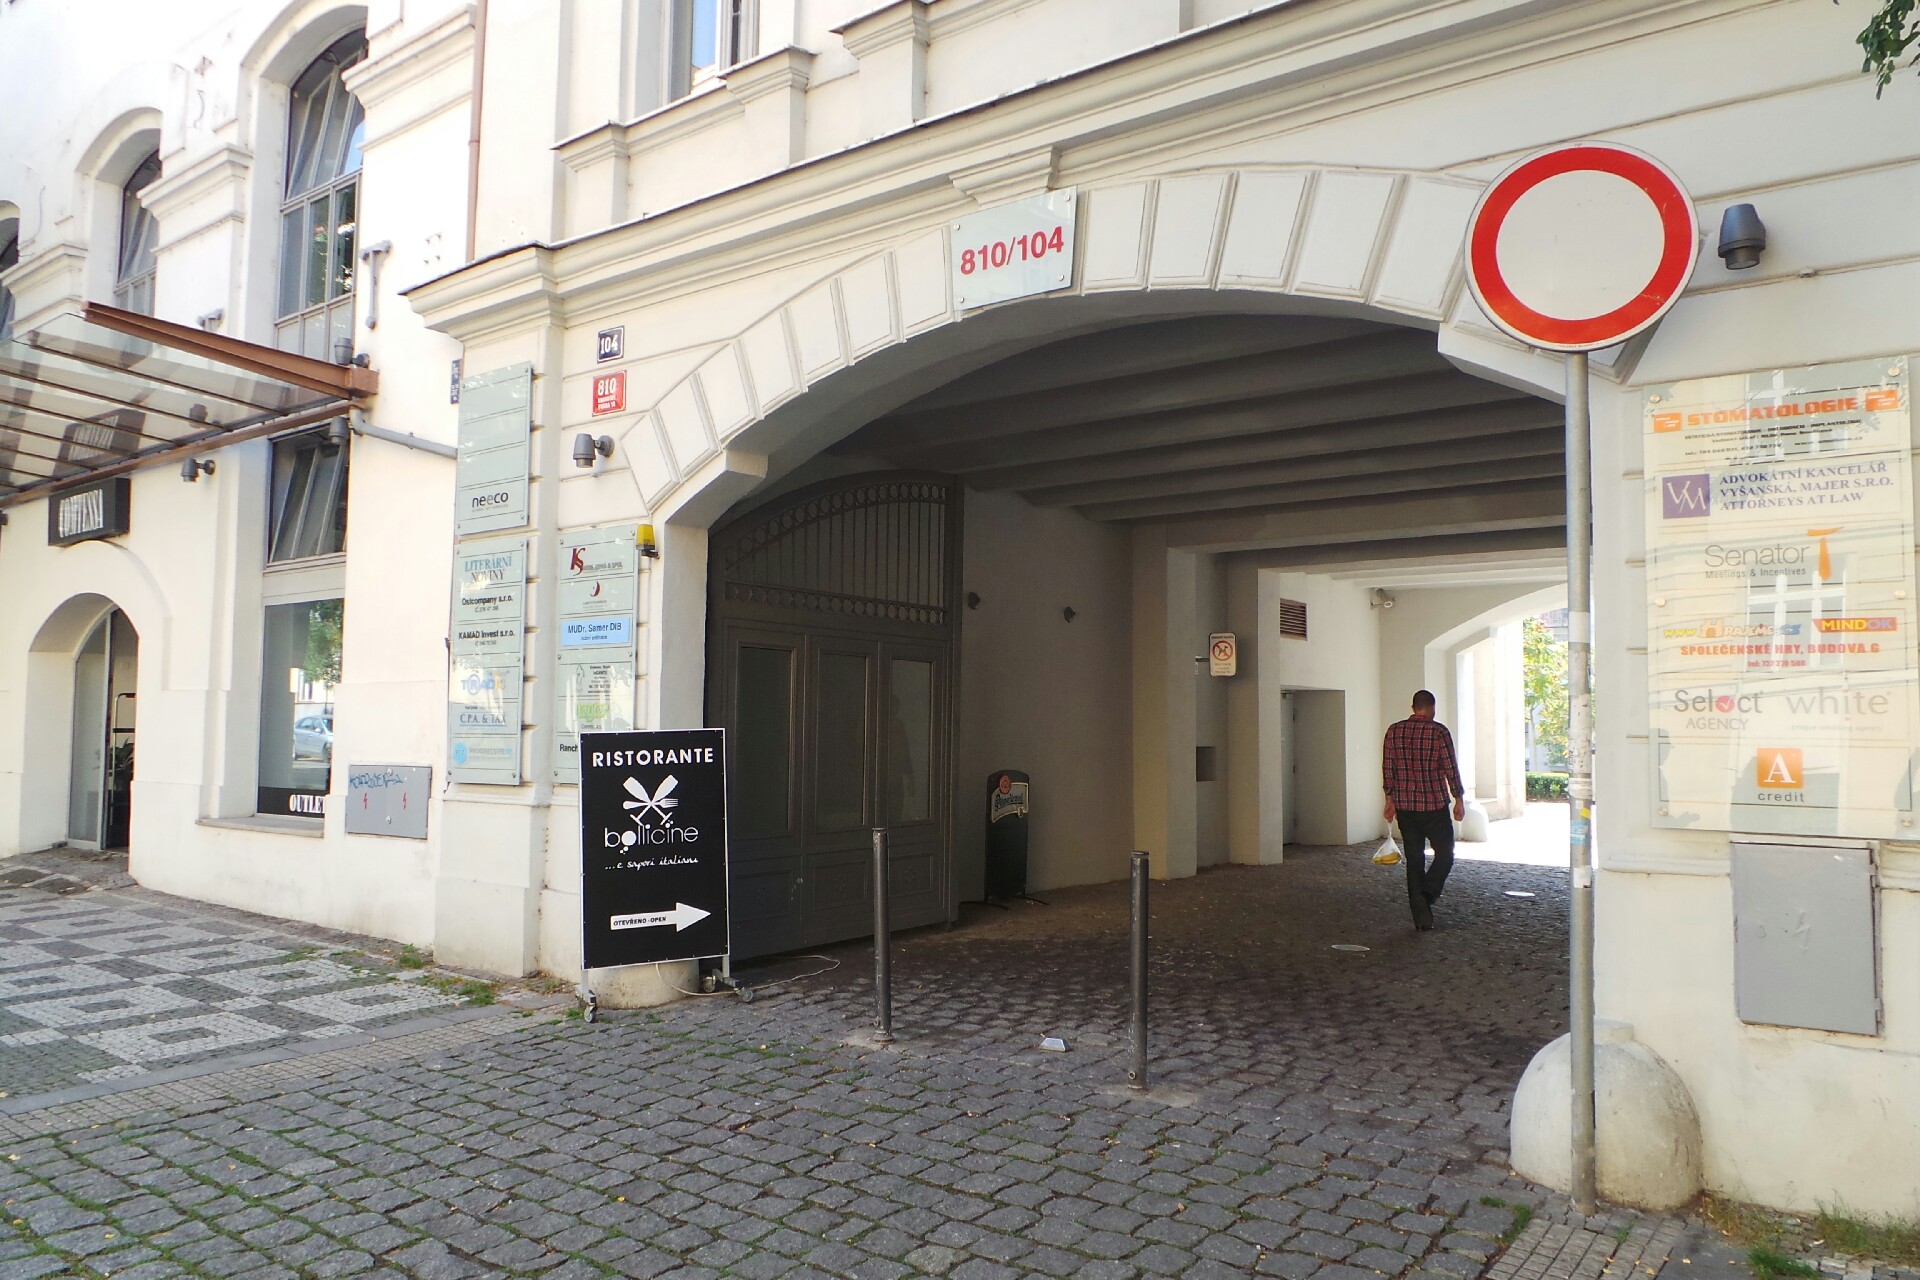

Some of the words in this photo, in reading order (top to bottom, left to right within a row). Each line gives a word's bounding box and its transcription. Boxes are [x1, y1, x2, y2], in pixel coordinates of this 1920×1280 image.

[960, 226, 1065, 275] 810/104
[600, 334, 619, 355] 104
[597, 377, 617, 396] 810
[1688, 396, 1859, 426] STOMATOLOGIE
[1720, 467, 1801, 485] ADVOKÁTNÍ
[1806, 460, 1887, 478] KANCELÁŘ
[1800, 479, 1850, 492] MAJER
[1853, 476, 1894, 488] S.R.O.
[471, 492, 509, 508] neeco
[1720, 496, 1804, 511] ATTORNEYS
[1807, 494, 1826, 505] AT
[1830, 492, 1864, 504] LAW
[464, 553, 512, 572] LITERÁRNÍ
[1704, 543, 1810, 567] Senator
[1705, 570, 1746, 579] Meetings
[1750, 568, 1756, 577] &
[1760, 567, 1806, 576] Incentives
[498, 595, 514, 603] s.r.o.
[588, 623, 609, 633] Samer
[1821, 619, 1891, 631] MINDOK
[459, 630, 480, 640] KAMAD
[1680, 643, 1771, 656] SPOLEČENSKÉ
[1807, 643, 1866, 653] BUDOVA
[1785, 686, 1889, 715] white
[1686, 717, 1749, 730] AGENCY
[592, 747, 714, 768] RISTORANTE
[1763, 752, 1797, 783] A
[1757, 791, 1805, 802] credit
[604, 821, 699, 848] bollicine
[627, 857, 655, 871] sapori
[613, 917, 647, 926] OTEVŘENO
